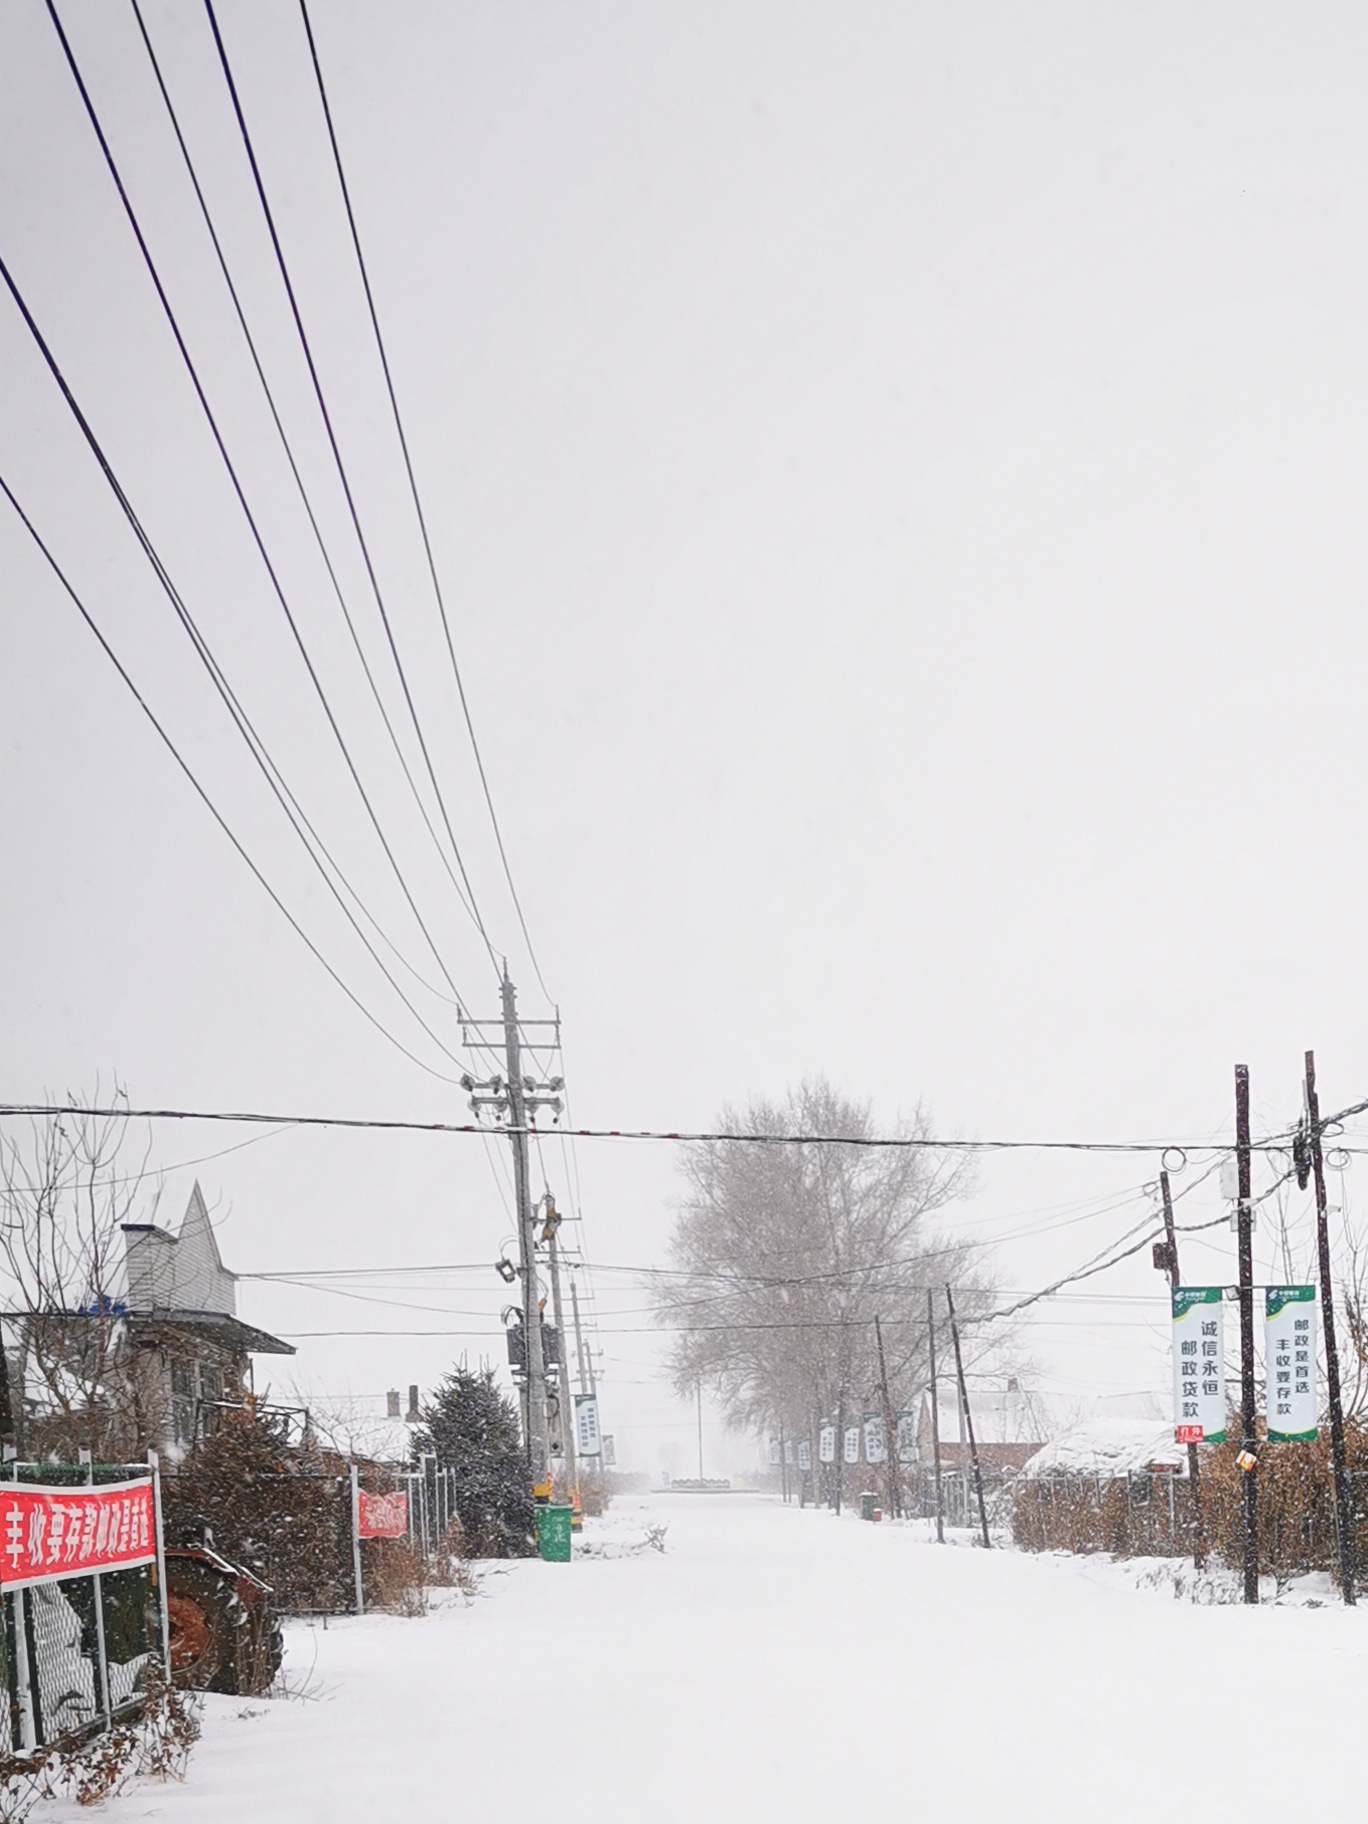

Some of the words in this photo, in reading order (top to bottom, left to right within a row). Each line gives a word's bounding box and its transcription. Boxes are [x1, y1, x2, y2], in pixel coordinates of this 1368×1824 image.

[1181, 1340, 1198, 1417] 邮政贷款
[1201, 1321, 1218, 1395] 诚信永恒
[1276, 1338, 1292, 1415] 丰收要存款
[1294, 1319, 1309, 1393] 邮政是首选
